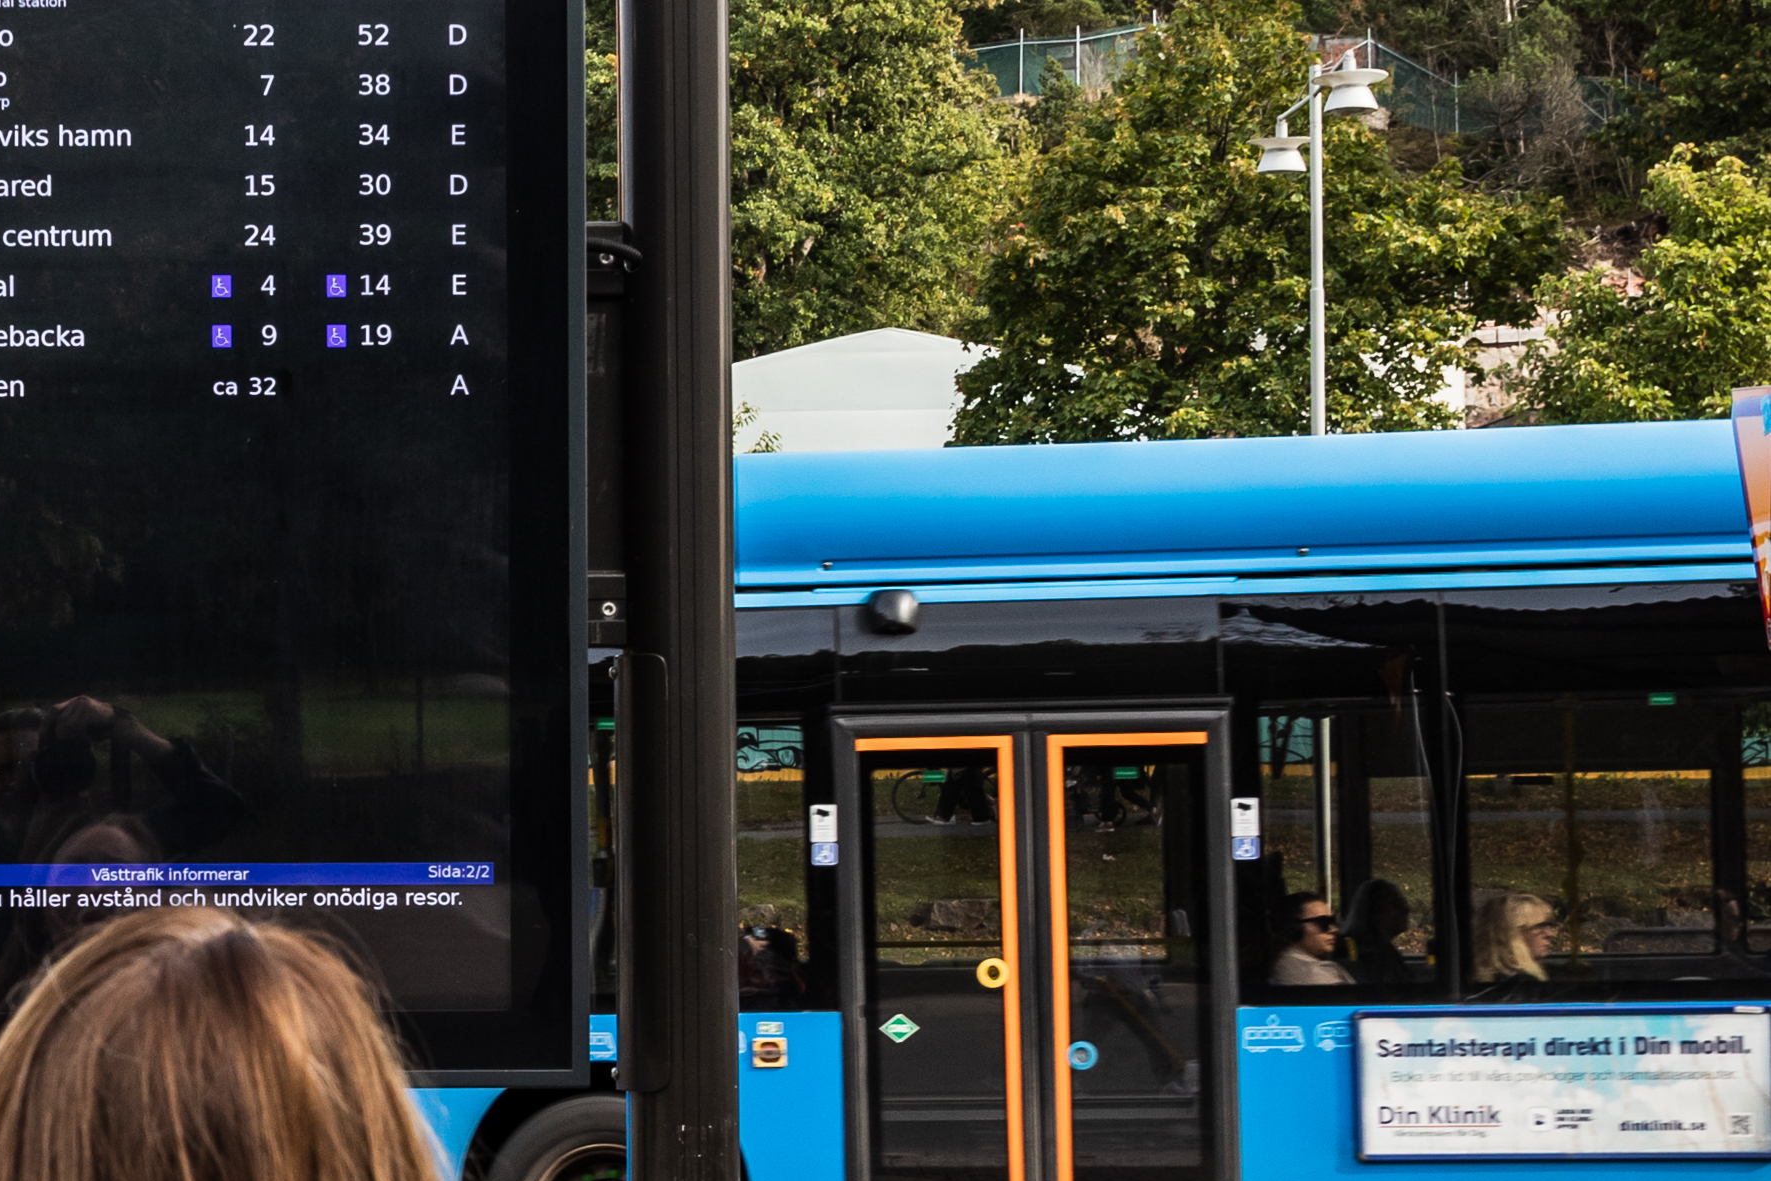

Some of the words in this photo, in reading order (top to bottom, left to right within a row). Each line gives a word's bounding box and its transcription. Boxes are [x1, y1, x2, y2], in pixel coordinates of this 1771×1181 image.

[243, 23, 275, 47] 22
[357, 23, 390, 46] 52
[448, 23, 468, 46] D
[260, 74, 275, 97] 7
[358, 73, 391, 96] 38
[449, 73, 468, 96] D
[58, 123, 132, 147] hamn
[244, 124, 276, 147] 14
[358, 123, 391, 146] 34
[451, 123, 466, 146] E
[244, 174, 276, 197] 15
[358, 173, 392, 196] 30
[449, 173, 469, 196] D
[2, 225, 113, 248] centrum
[244, 223, 277, 247] 24
[359, 223, 392, 246] 39
[451, 223, 467, 246] E
[260, 274, 277, 297] 4
[360, 274, 392, 296] 14
[452, 273, 467, 296] E
[261, 324, 278, 346] 9
[360, 323, 392, 346] 19
[449, 324, 470, 346] A
[212, 381, 238, 396] ca
[248, 376, 277, 396] 32
[450, 374, 470, 396] A
[91, 867, 164, 882] Västtrafik
[168, 867, 250, 881] informerar
[427, 863, 490, 880] Sida:2/2
[10, 887, 72, 908] håller
[77, 886, 162, 908] avstånd
[168, 888, 207, 907] och
[213, 887, 308, 907] undviker
[313, 887, 398, 911] onödiga
[405, 891, 463, 906] resor.
[1376, 1037, 1537, 1060] Samtalsterapi
[1544, 1036, 1613, 1056] direkt
[1618, 1036, 1626, 1055] i
[1635, 1035, 1671, 1055] Din
[1680, 1034, 1752, 1054] mobil.
[1378, 1105, 1420, 1125] Din
[1428, 1104, 1502, 1124] Klinik
